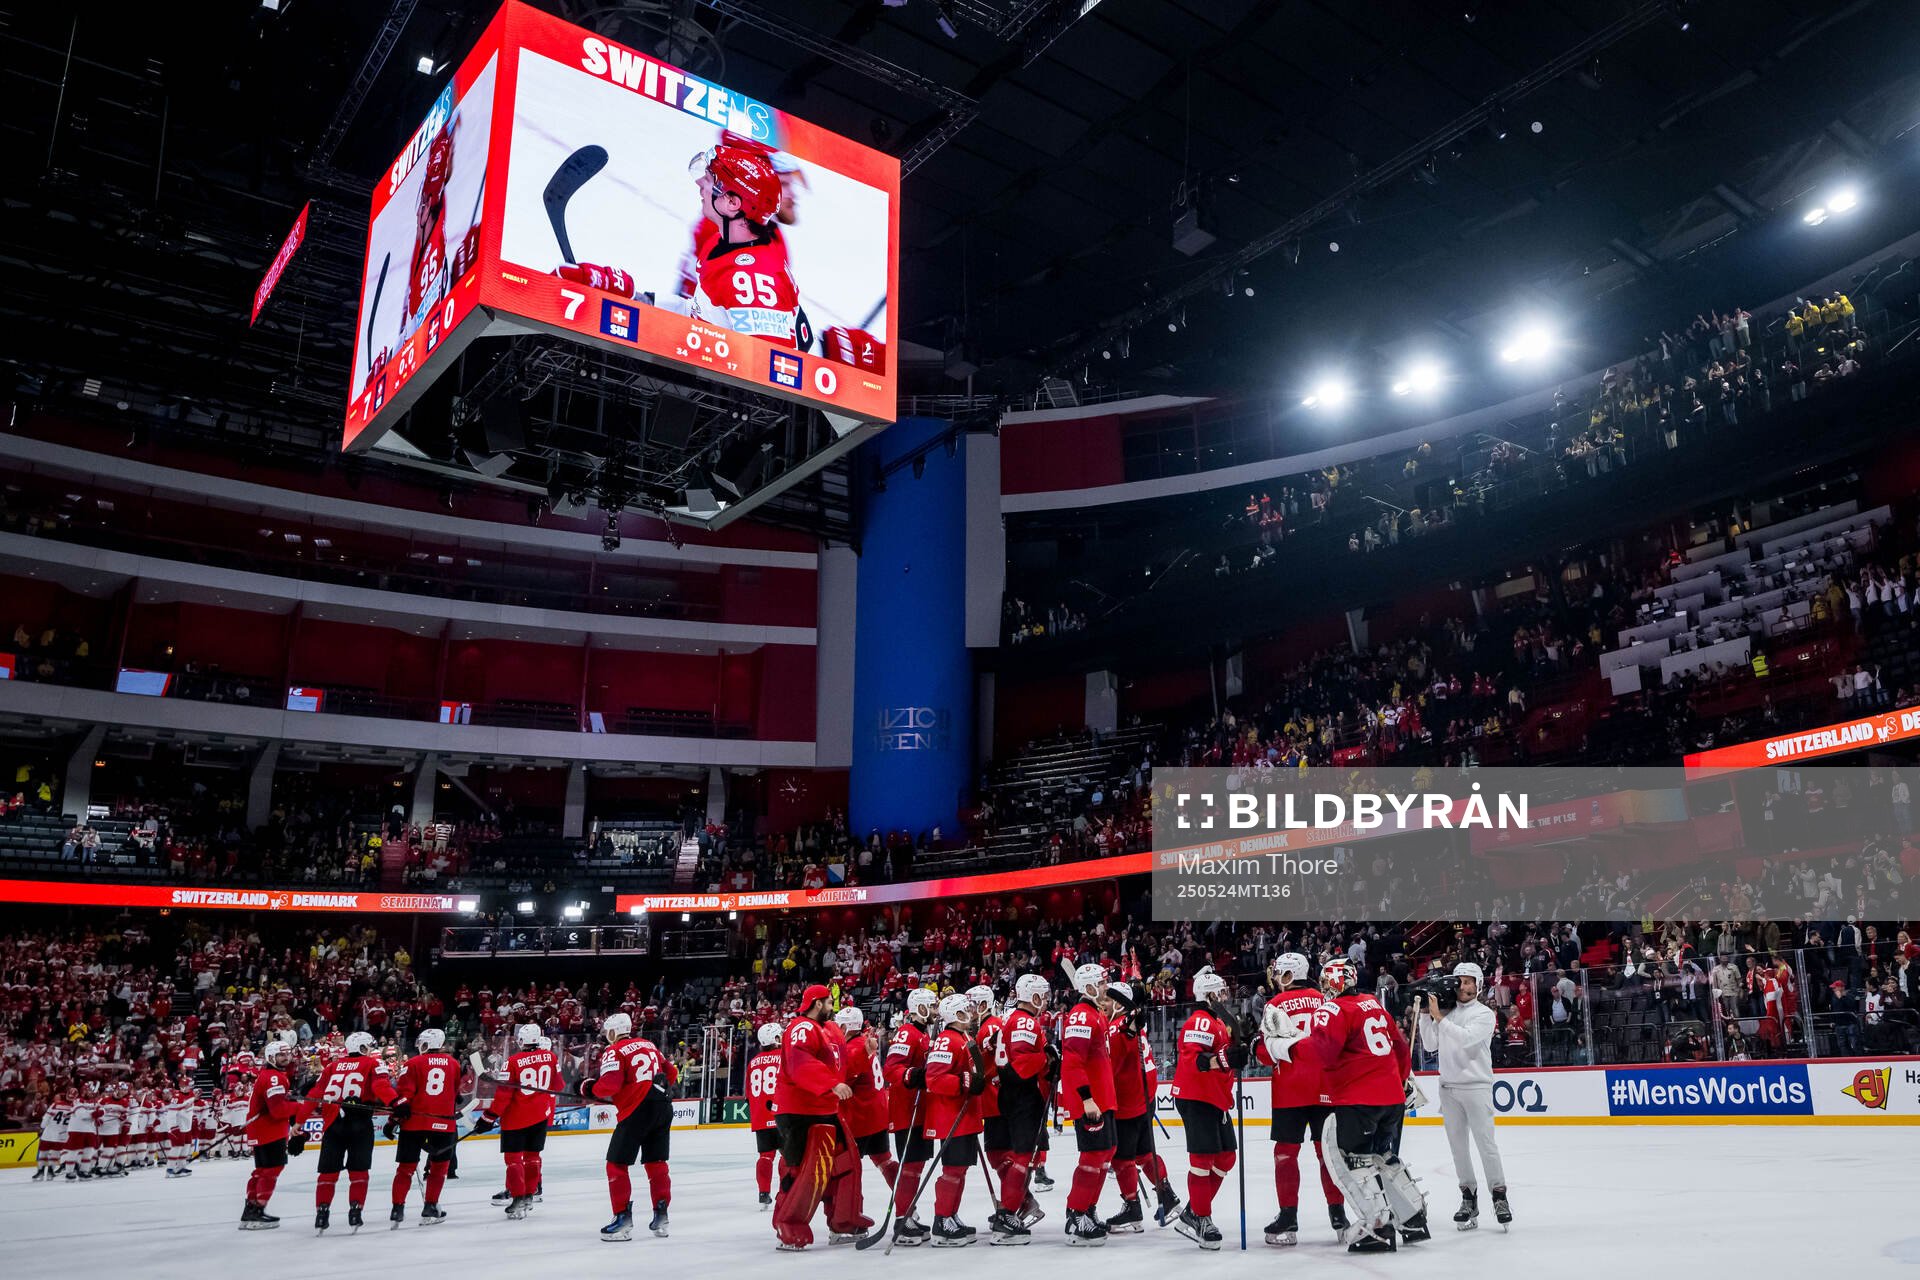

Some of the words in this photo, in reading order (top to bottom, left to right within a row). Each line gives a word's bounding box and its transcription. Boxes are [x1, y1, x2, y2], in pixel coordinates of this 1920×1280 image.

[421, 247, 438, 298] 95
[502, 272, 528, 285] PENALTY
[732, 271, 778, 307] 95
[560, 288, 586, 321] 7
[443, 298, 455, 329] 0
[752, 309, 789, 324] DANSK
[610, 324, 628, 338] SUI
[703, 328, 727, 341] Period
[753, 320, 790, 337] METAL
[726, 361, 738, 371] 17
[814, 366, 837, 395] 0
[1765, 722, 1874, 759] SWITZERLAND
[1240, 834, 1289, 852] DENMARK
[171, 890, 269, 906] SWITZERLAND
[292, 893, 358, 908] DENMARK
[643, 896, 720, 909] SWITZERLAND
[738, 892, 789, 906] DENMARK
[1017, 1017, 1035, 1031] 28
[1069, 1012, 1087, 1025] 54
[1195, 1017, 1211, 1031] 10
[1314, 1011, 1330, 1027] 63
[933, 1037, 950, 1051] 62
[1193, 1033, 1214, 1045] TISSOT
[1363, 1014, 1393, 1057] 6
[517, 1053, 552, 1068] BAECHLER
[602, 1049, 616, 1065] 22
[270, 1075, 279, 1086] 9
[323, 1072, 365, 1101] 56
[425, 1067, 446, 1096] 8
[519, 1064, 552, 1096] 80
[1612, 1075, 1807, 1107] #MensWorlds
